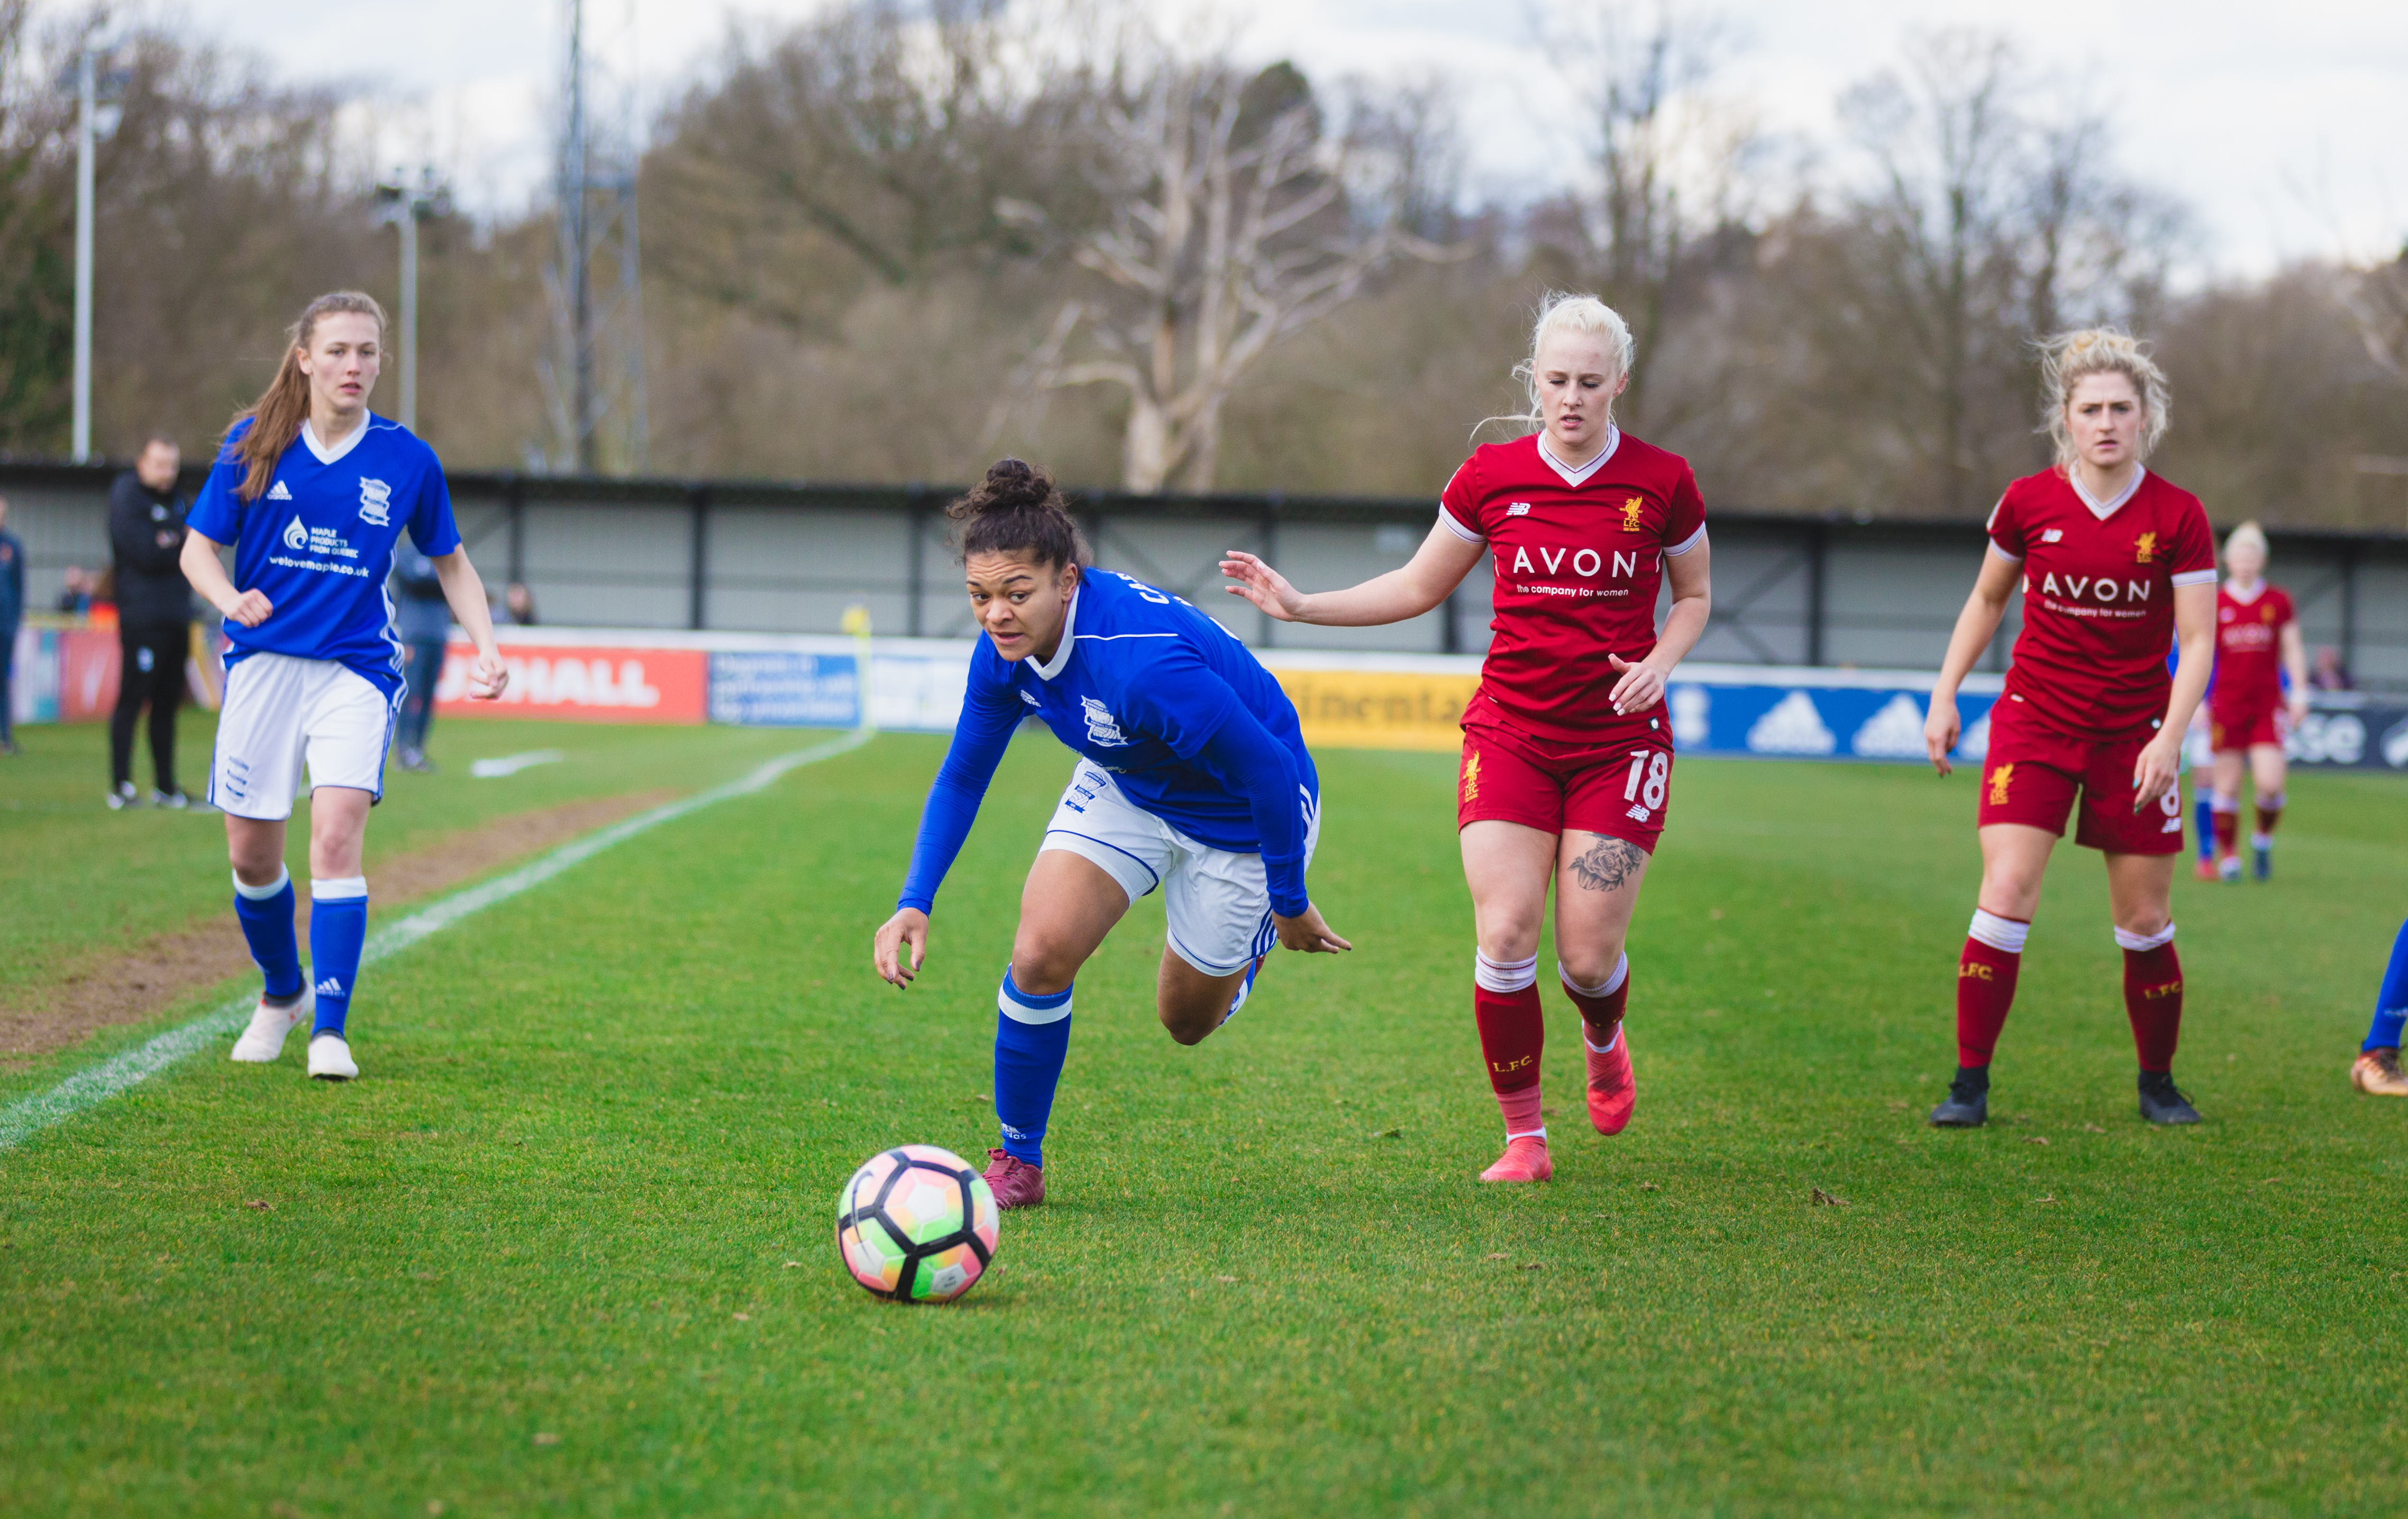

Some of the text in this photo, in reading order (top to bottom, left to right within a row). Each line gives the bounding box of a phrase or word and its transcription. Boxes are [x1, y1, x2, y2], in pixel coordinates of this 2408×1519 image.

[310, 535, 348, 547] PRODUCTS
[311, 527, 337, 538] MAPLE
[309, 545, 359, 558] FROM QUEBEC
[269, 556, 369, 577] welovemaple.co.uk
[1513, 547, 1636, 578] AVON
[1517, 584, 1529, 593] the
[1531, 586, 1577, 597] company
[1579, 587, 1594, 596] for
[2042, 571, 2151, 602] AVON
[2044, 598, 2057, 610] the
[2058, 604, 2098, 617] company
[2100, 607, 2112, 617] for
[1624, 750, 1668, 810] 18
